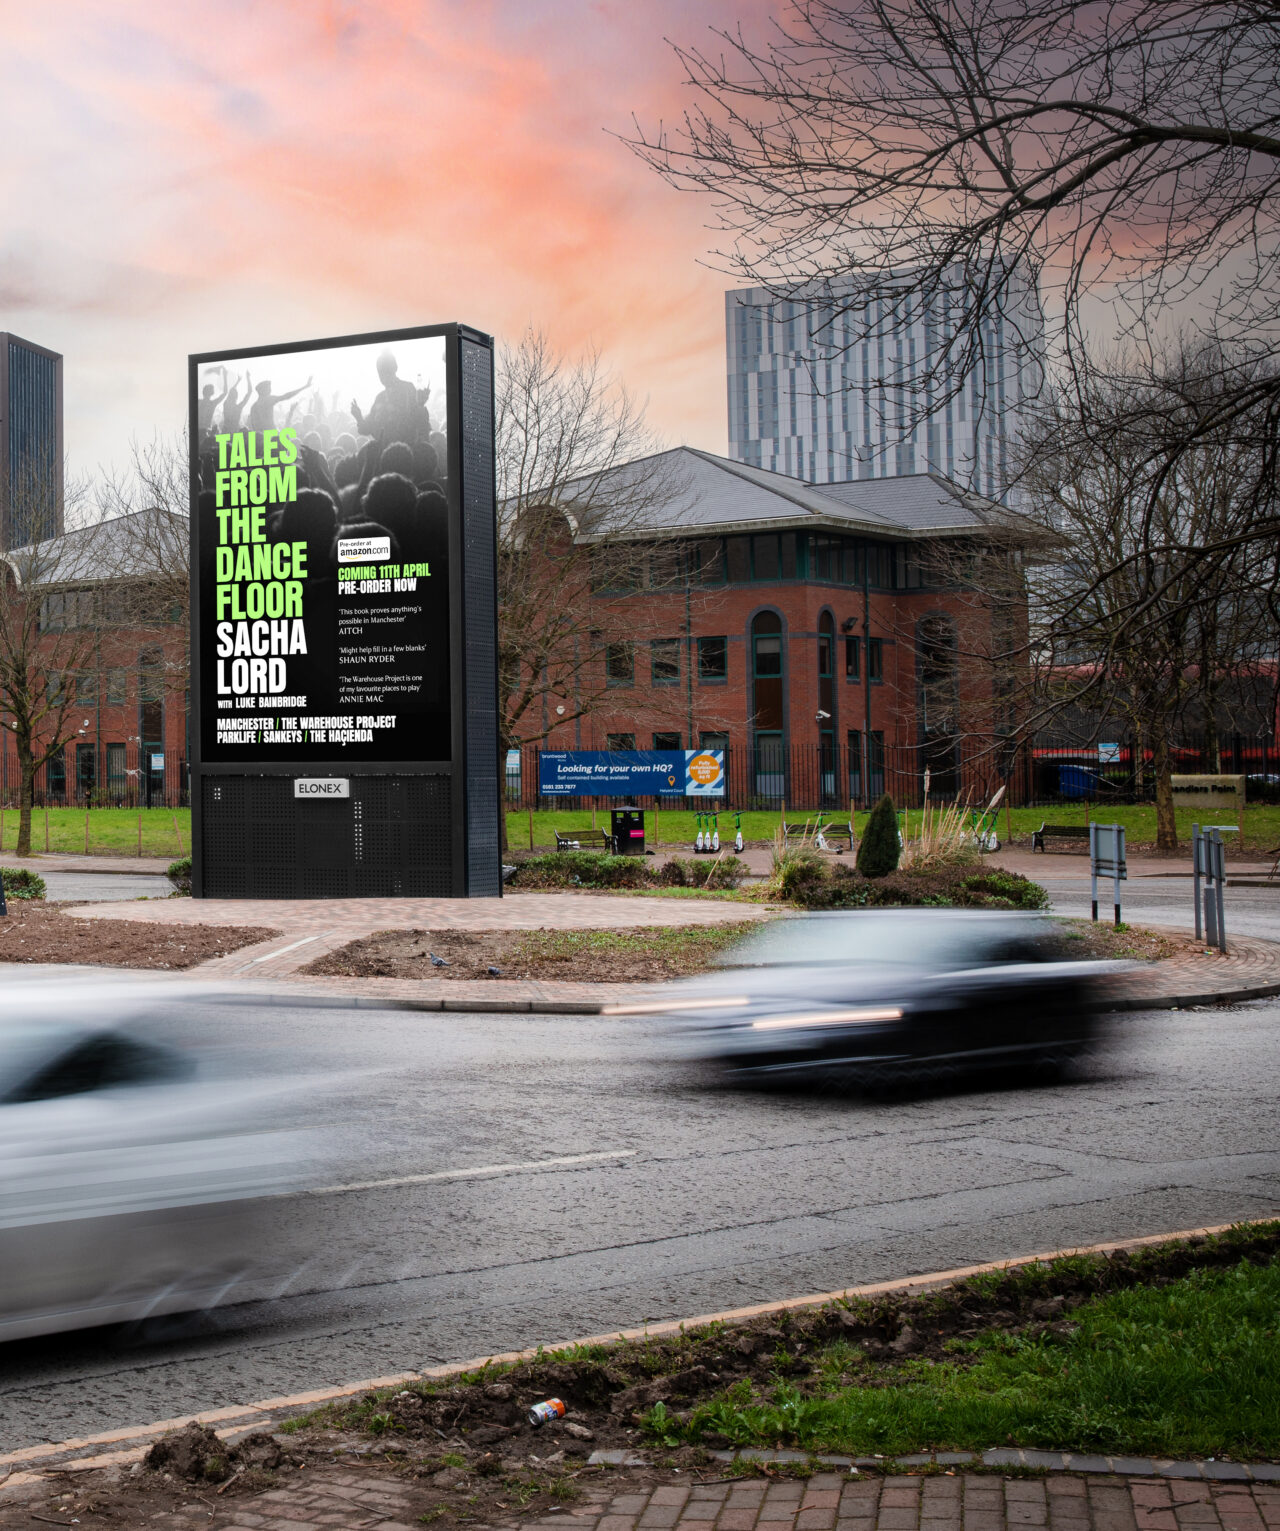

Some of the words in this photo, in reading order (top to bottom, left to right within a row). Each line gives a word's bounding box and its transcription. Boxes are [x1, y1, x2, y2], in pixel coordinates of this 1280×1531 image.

[216, 427, 297, 469] TALES
[216, 466, 297, 507] FROM
[216, 506, 266, 545] THE
[340, 546, 389, 556] amazon.com
[216, 541, 308, 582] DANCE
[338, 566, 377, 581] COMING
[379, 564, 400, 579] 11TH
[403, 563, 431, 578] APRIL
[338, 579, 391, 595] PRE-ORDER
[393, 577, 417, 592] NOW
[217, 581, 304, 620] FLOOR
[370, 607, 390, 615] proves
[339, 617, 362, 626] possible
[339, 627, 363, 635] AITCH
[217, 619, 308, 657] SACHA
[359, 646, 372, 655] help
[381, 645, 388, 653] in
[339, 656, 367, 664] SHAUN
[368, 655, 395, 663] RYDER
[217, 658, 287, 694] LORD
[352, 675, 384, 683] Warehouse
[384, 674, 405, 683] Project
[405, 674, 411, 682] is
[381, 684, 400, 693] places
[218, 700, 232, 708] WITH
[235, 697, 256, 708] LUKE
[259, 696, 307, 708] BAINBRIDGE
[339, 695, 364, 704] ANNIE
[365, 694, 384, 703] MAC
[217, 718, 274, 731] MANCHESTER
[281, 717, 298, 730] THE
[300, 716, 354, 729] WAREHOUSE
[356, 715, 396, 728] PROJECT
[217, 731, 256, 744] PARKLIFE
[263, 730, 302, 743] SANKEYS
[310, 730, 326, 743] THE
[328, 729, 373, 746] HAÇIENDA
[557, 764, 593, 774] Looking
[594, 764, 608, 772] for
[609, 765, 630, 773] your
[652, 764, 673, 773] HQ?
[299, 783, 342, 794] ELONEX
